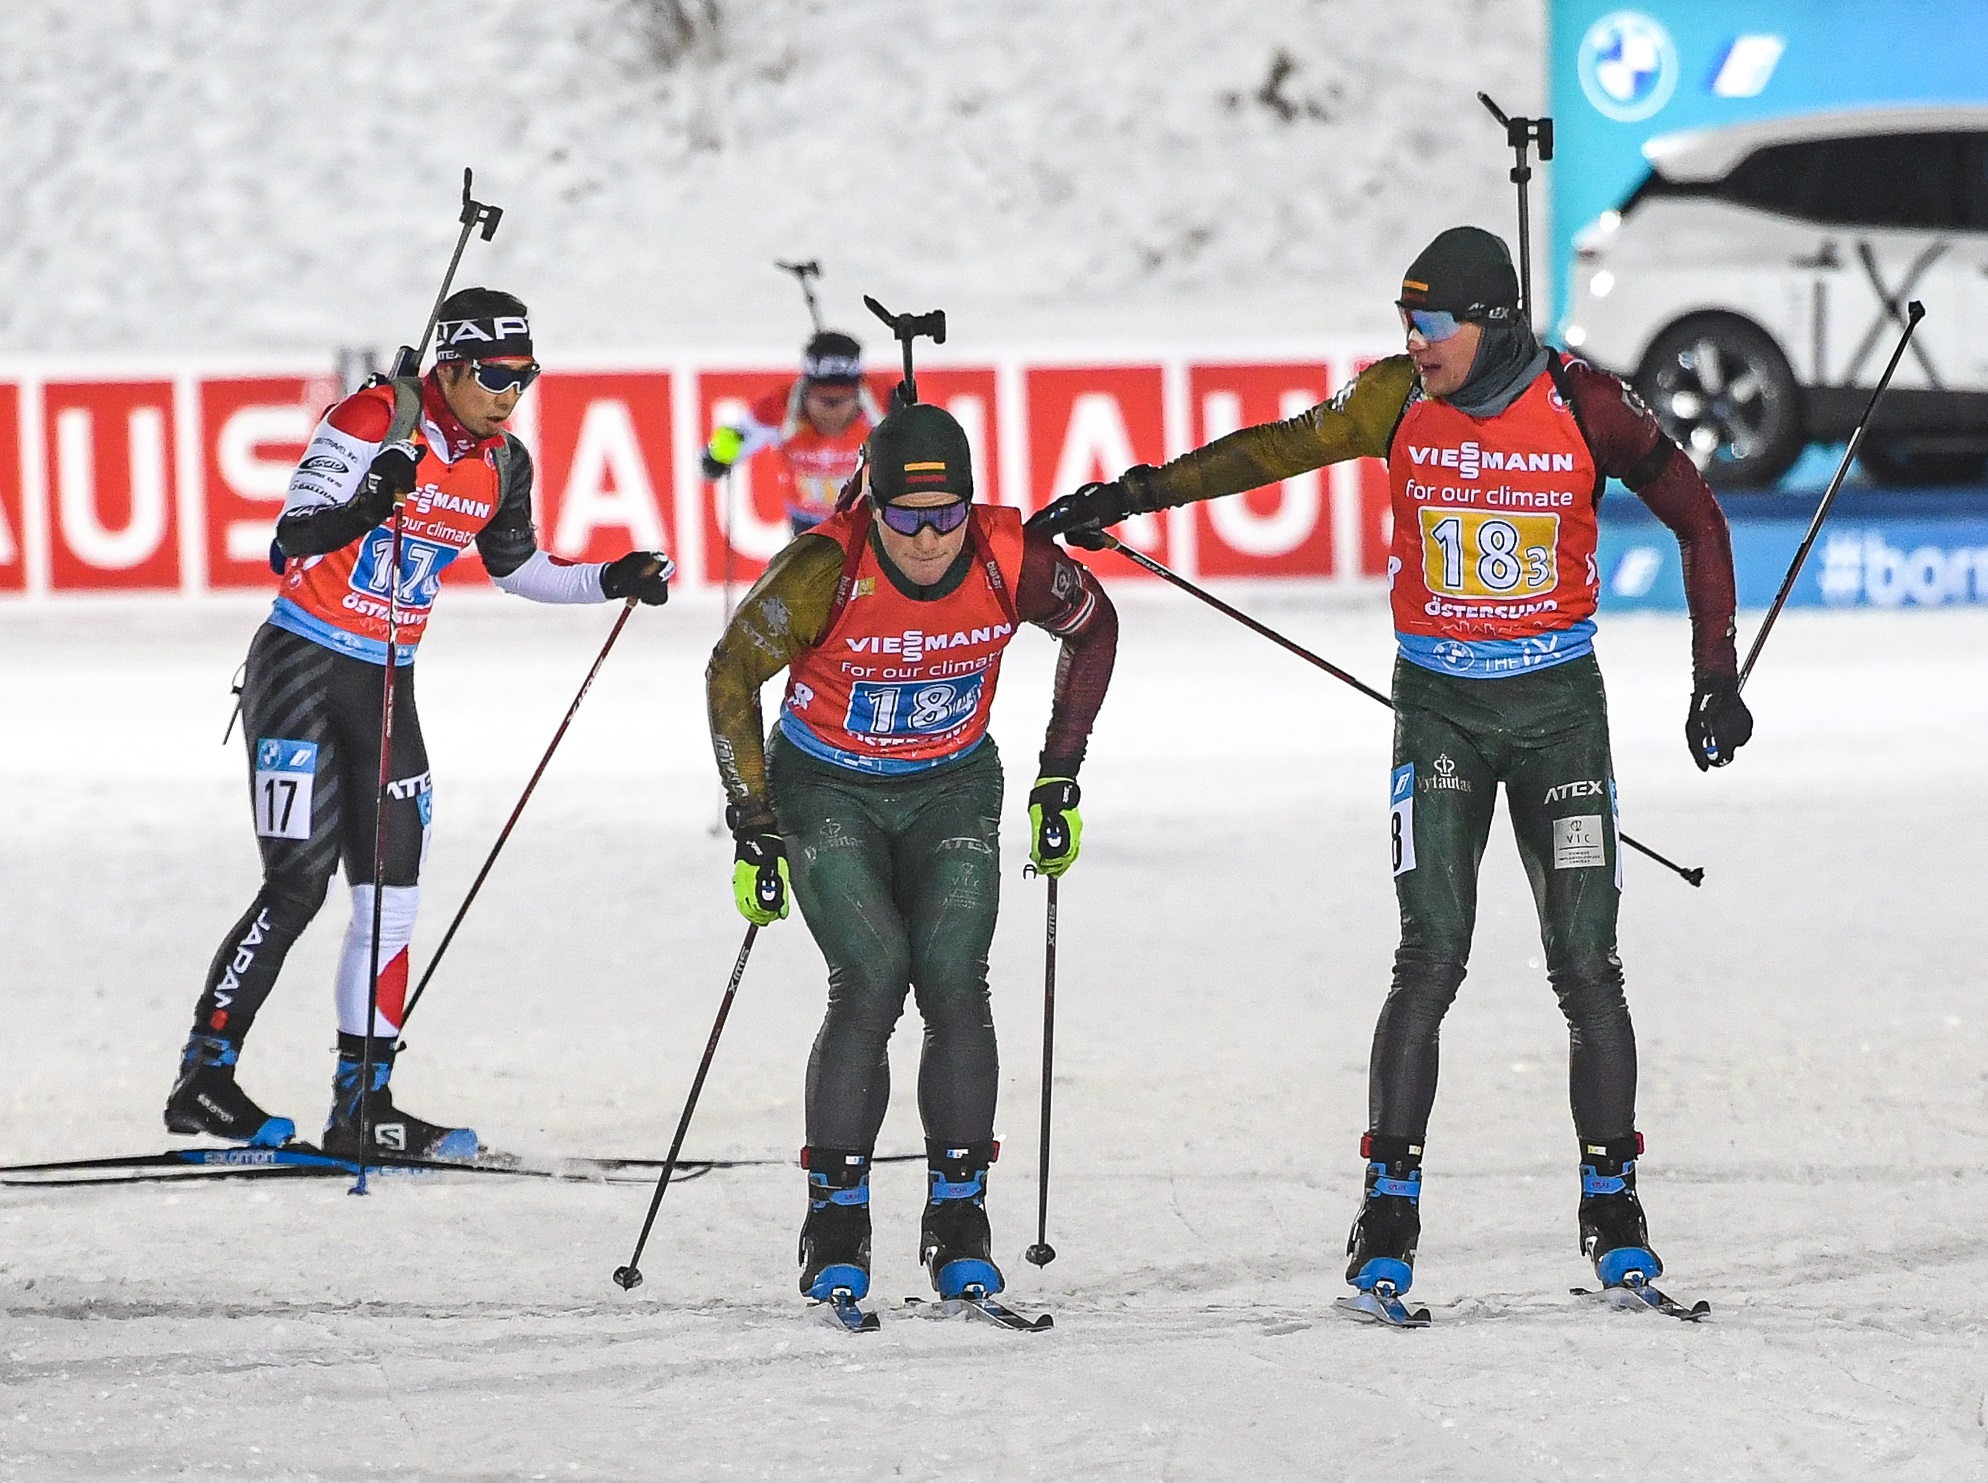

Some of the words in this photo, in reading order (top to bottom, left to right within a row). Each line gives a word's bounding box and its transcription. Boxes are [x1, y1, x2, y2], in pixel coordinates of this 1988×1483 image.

[1408, 441, 1573, 479] VIESSMANN
[1406, 478, 1436, 500] for
[1441, 485, 1480, 503] our
[1486, 486, 1573, 508] climate
[845, 622, 1012, 663] VIESSMANN
[882, 666, 924, 679] our
[264, 779, 298, 833] 17
[1544, 780, 1604, 805] ATEX
[1566, 834, 1590, 844] VIC
[728, 946, 749, 994] SWIX
